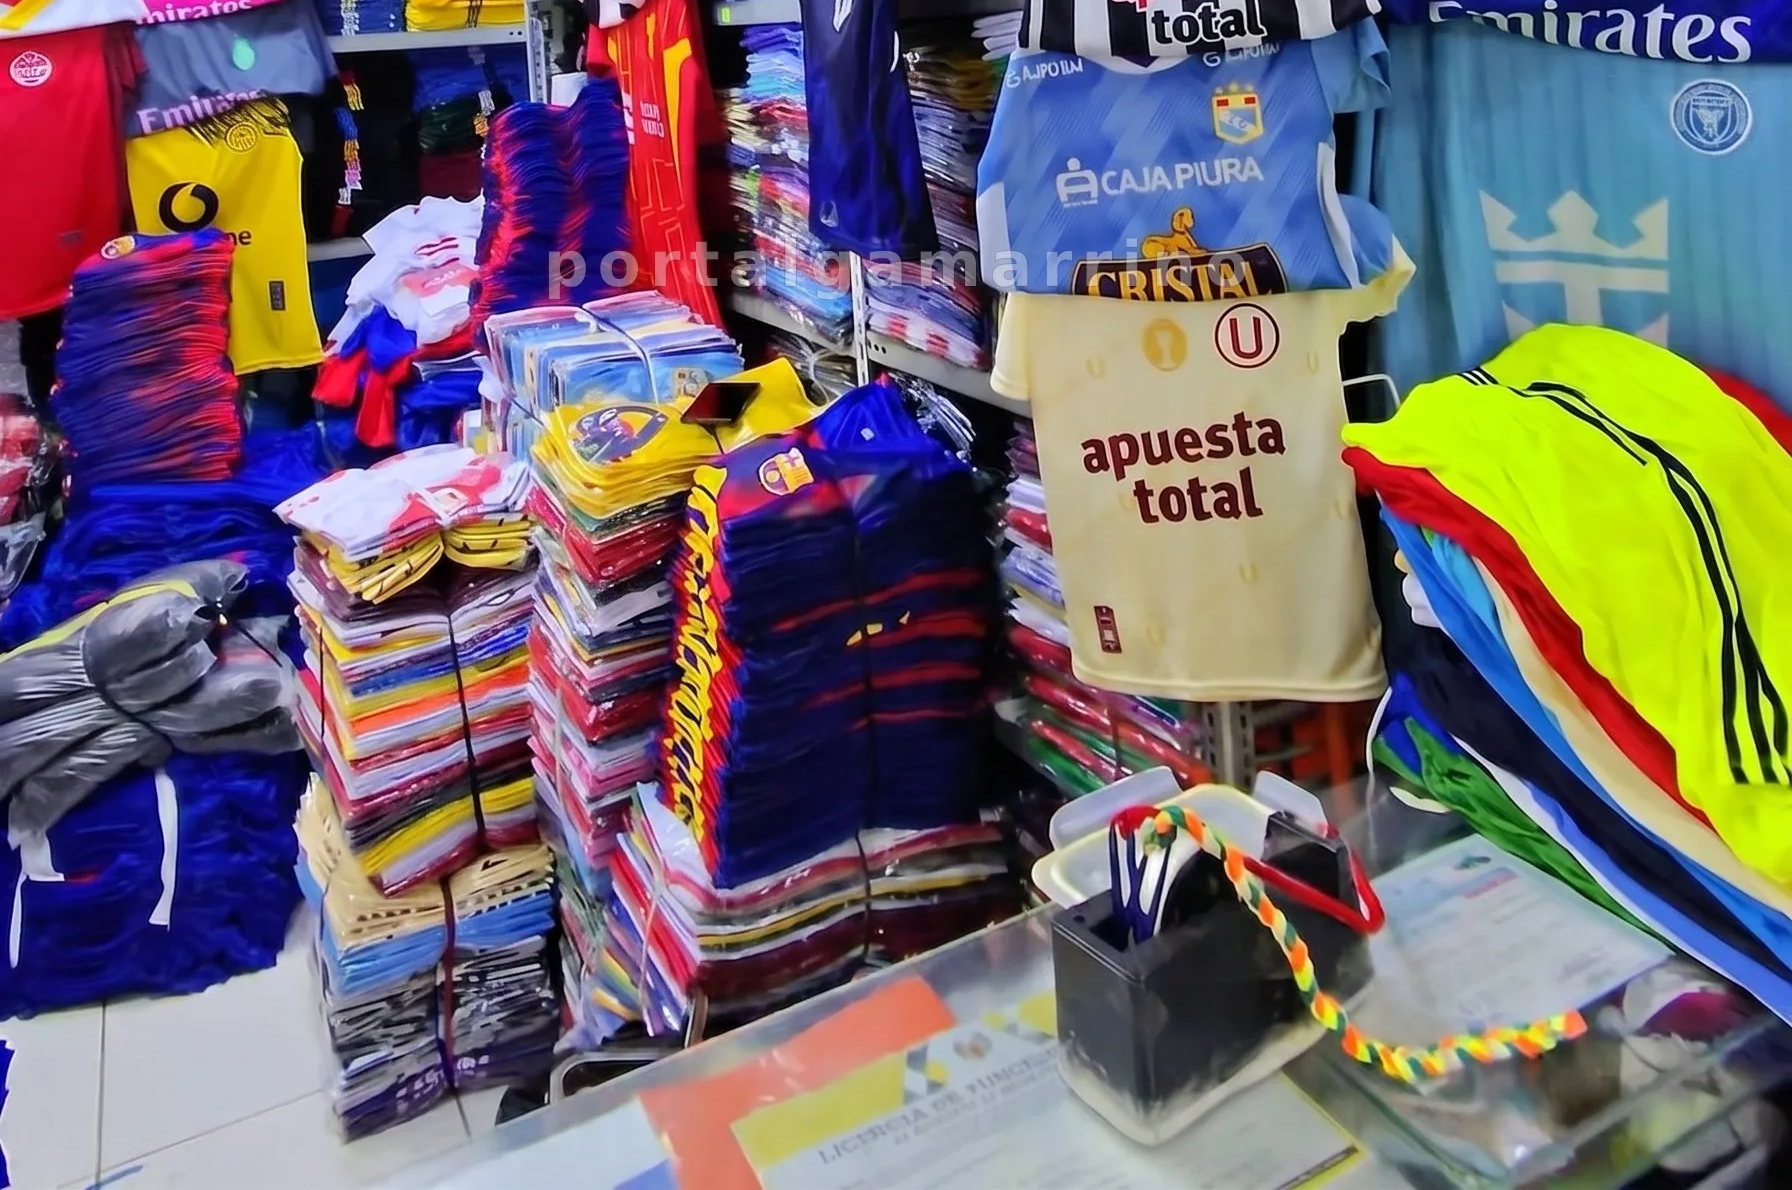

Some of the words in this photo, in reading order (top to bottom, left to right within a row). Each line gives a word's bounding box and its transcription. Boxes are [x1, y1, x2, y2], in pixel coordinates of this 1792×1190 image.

[1101, 165, 1174, 197] CAJA
[1174, 156, 1265, 190] PIURA
[1228, 315, 1263, 360] U
[1080, 411, 1287, 482] apuesta
[1133, 466, 1264, 524] total
